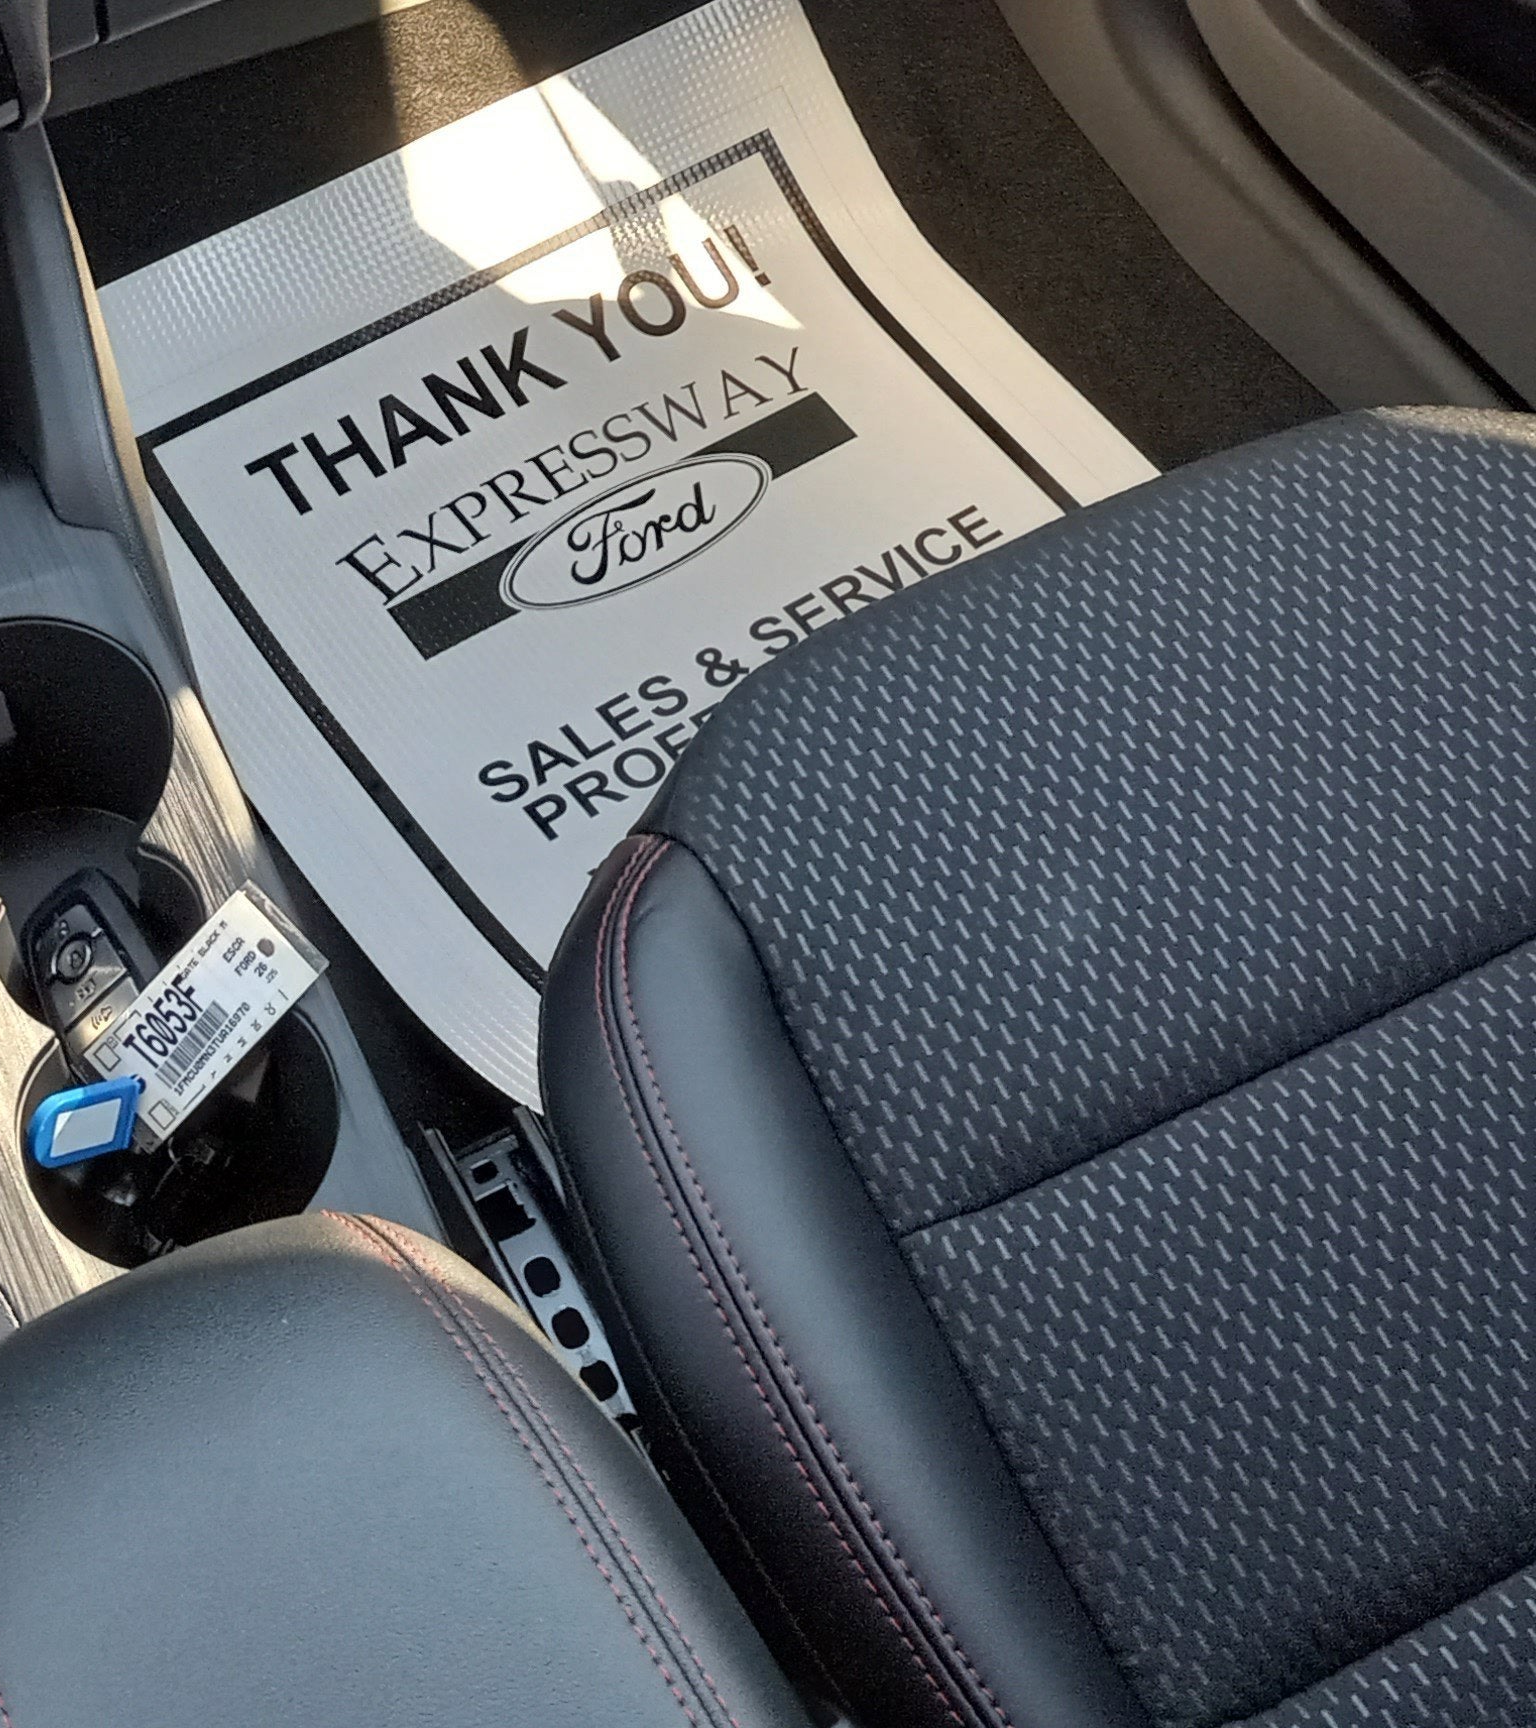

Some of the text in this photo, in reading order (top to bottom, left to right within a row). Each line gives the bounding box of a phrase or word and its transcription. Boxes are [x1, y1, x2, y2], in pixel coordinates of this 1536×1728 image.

[243, 223, 773, 517] THANK YOU!
[566, 480, 718, 586] Ford
[477, 504, 1005, 804] SALES & SERVICE
[198, 931, 221, 958] BLACK
[222, 936, 246, 964] ESCA
[234, 950, 257, 977] FORD
[253, 961, 269, 978] 26
[122, 973, 204, 1069] T6053F
